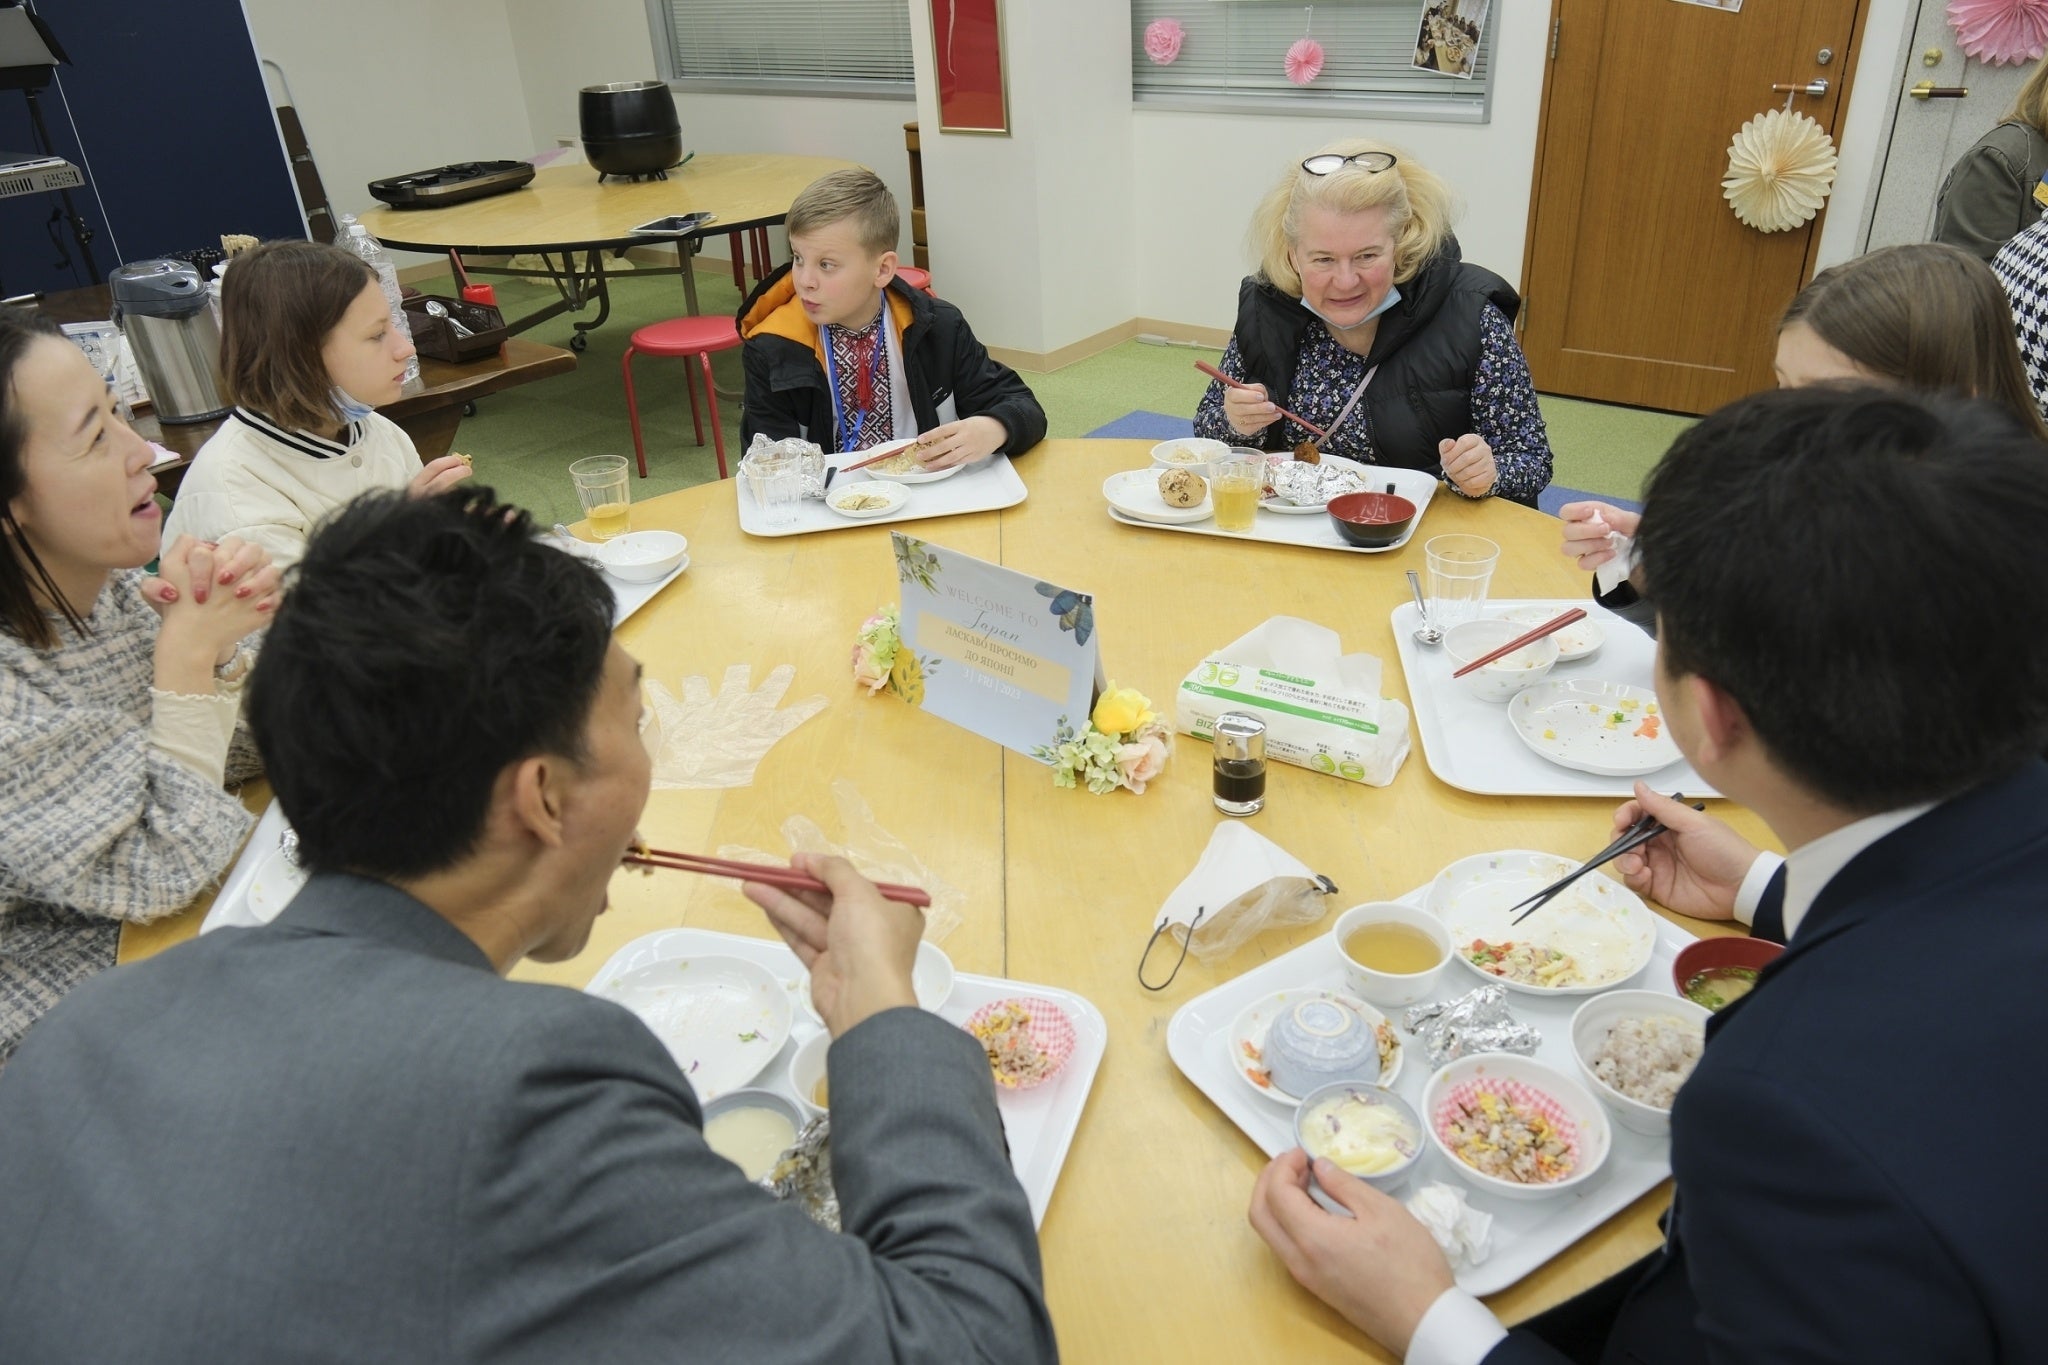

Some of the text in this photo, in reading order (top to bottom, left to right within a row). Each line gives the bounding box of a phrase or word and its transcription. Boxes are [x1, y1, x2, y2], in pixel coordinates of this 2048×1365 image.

[946, 583, 1039, 628] WELCOME TO
[964, 608, 1020, 641] Japan
[945, 625, 1037, 668] ЛАСКАВО ПРОСИМО
[965, 650, 978, 663] ДО
[1000, 682, 1022, 700] 2023
